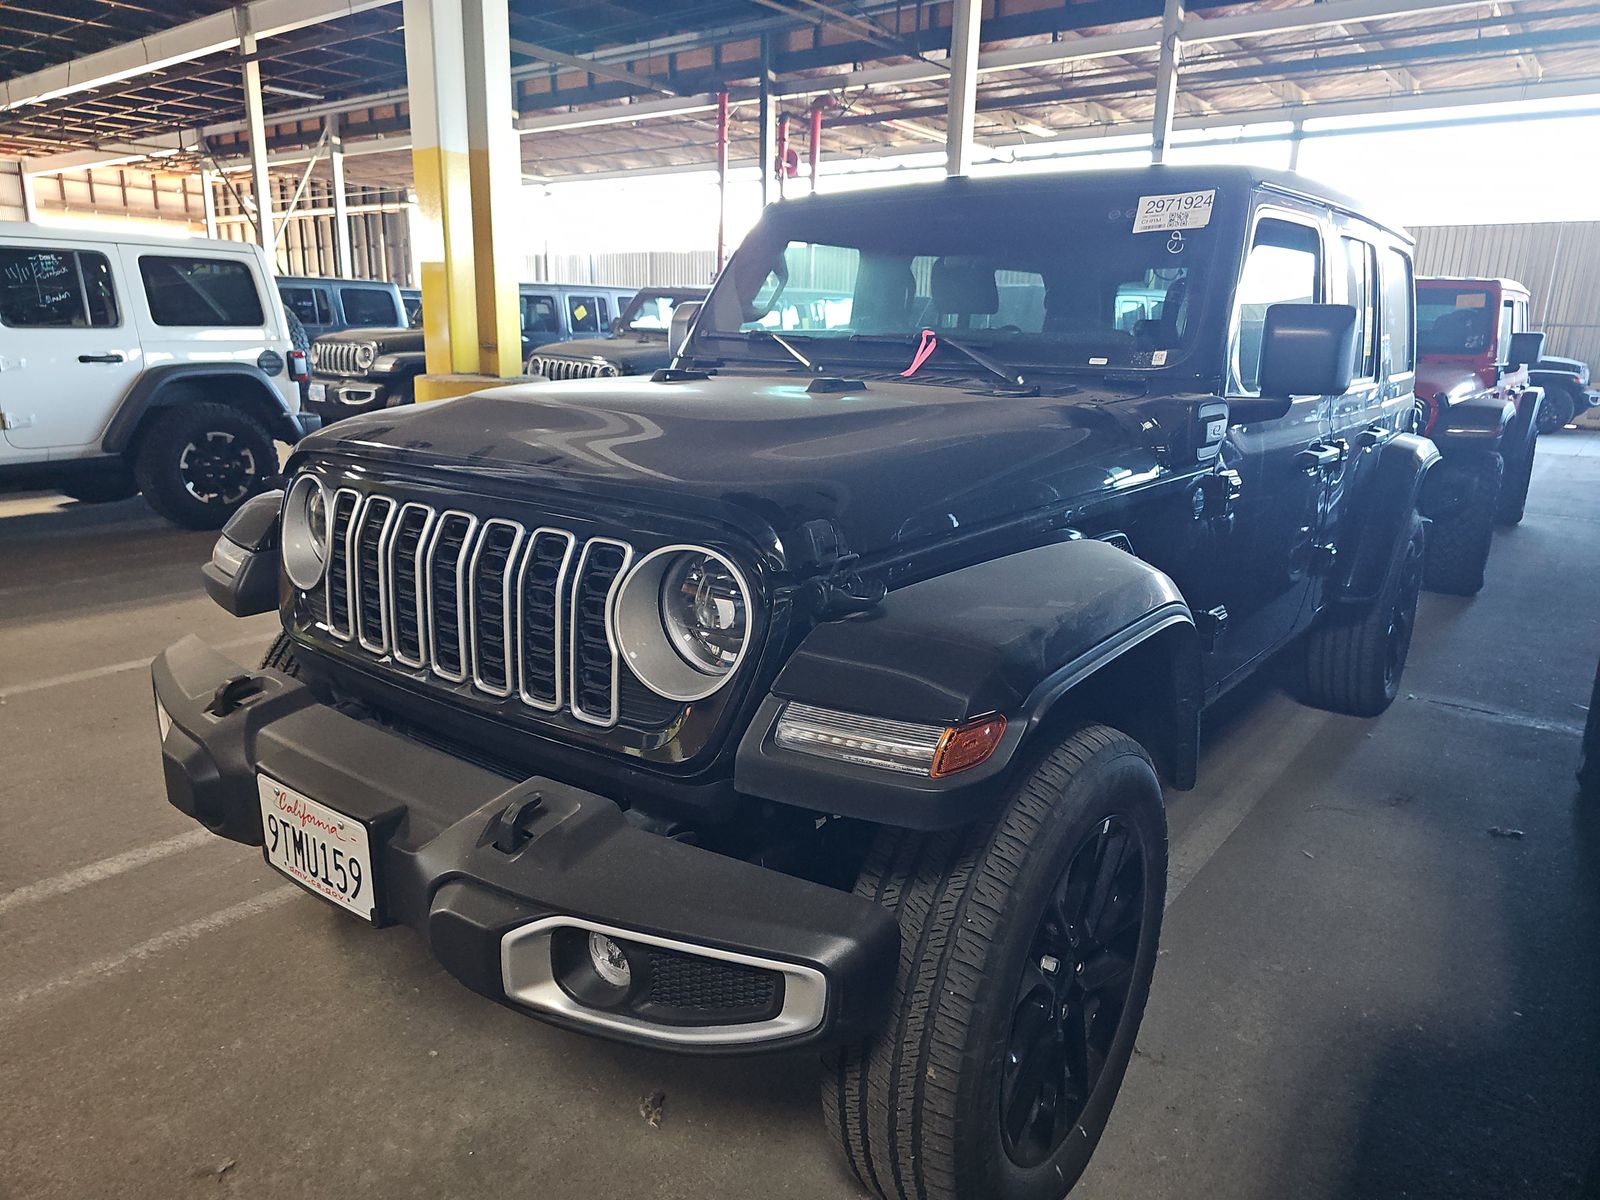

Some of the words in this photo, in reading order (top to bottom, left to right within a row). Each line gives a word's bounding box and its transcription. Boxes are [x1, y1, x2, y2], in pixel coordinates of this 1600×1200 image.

[1145, 194, 1212, 214] 2971924
[279, 791, 347, 841] California
[268, 813, 363, 900] 9TMU159
[288, 865, 344, 901] dmv.ca.gov
